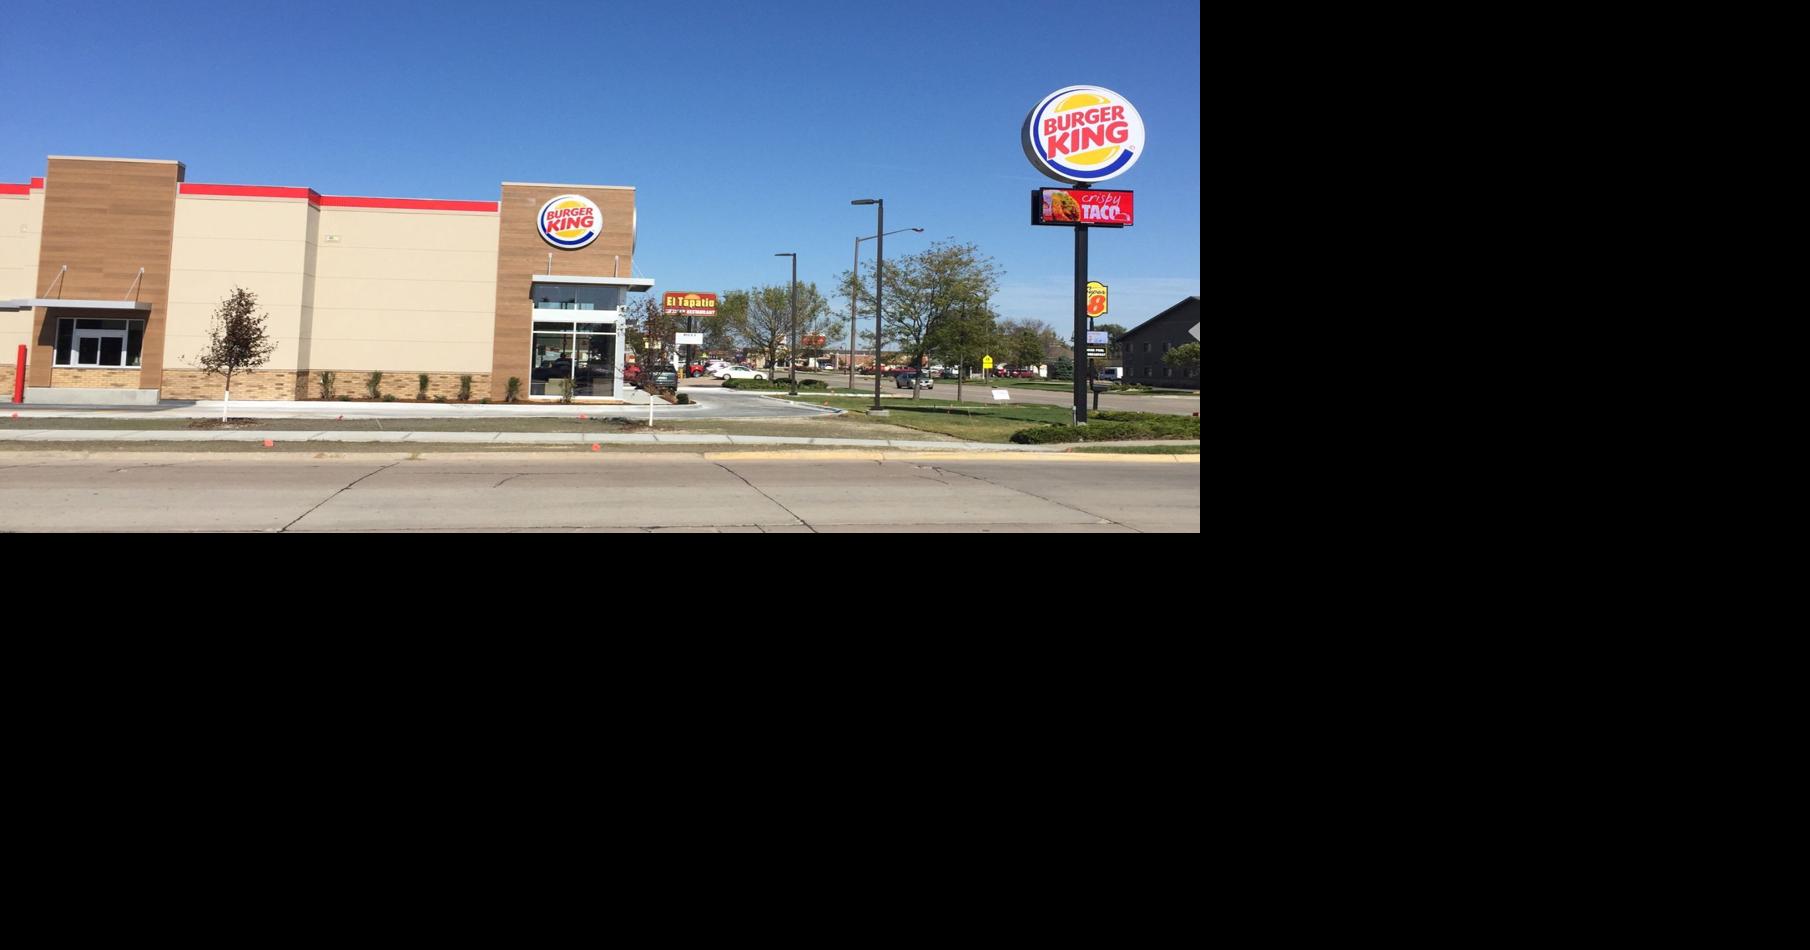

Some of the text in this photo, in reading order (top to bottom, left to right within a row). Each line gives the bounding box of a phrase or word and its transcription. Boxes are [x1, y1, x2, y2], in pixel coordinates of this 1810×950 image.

[1044, 105, 1125, 136] BURGER
[1048, 121, 1129, 159] KING
[1081, 192, 1122, 207] crispy
[547, 207, 593, 221] BURGER
[1082, 204, 1121, 221] TACO
[547, 215, 594, 233] KING
[666, 296, 715, 308] El Tapatio
[1087, 294, 1105, 315] 8
